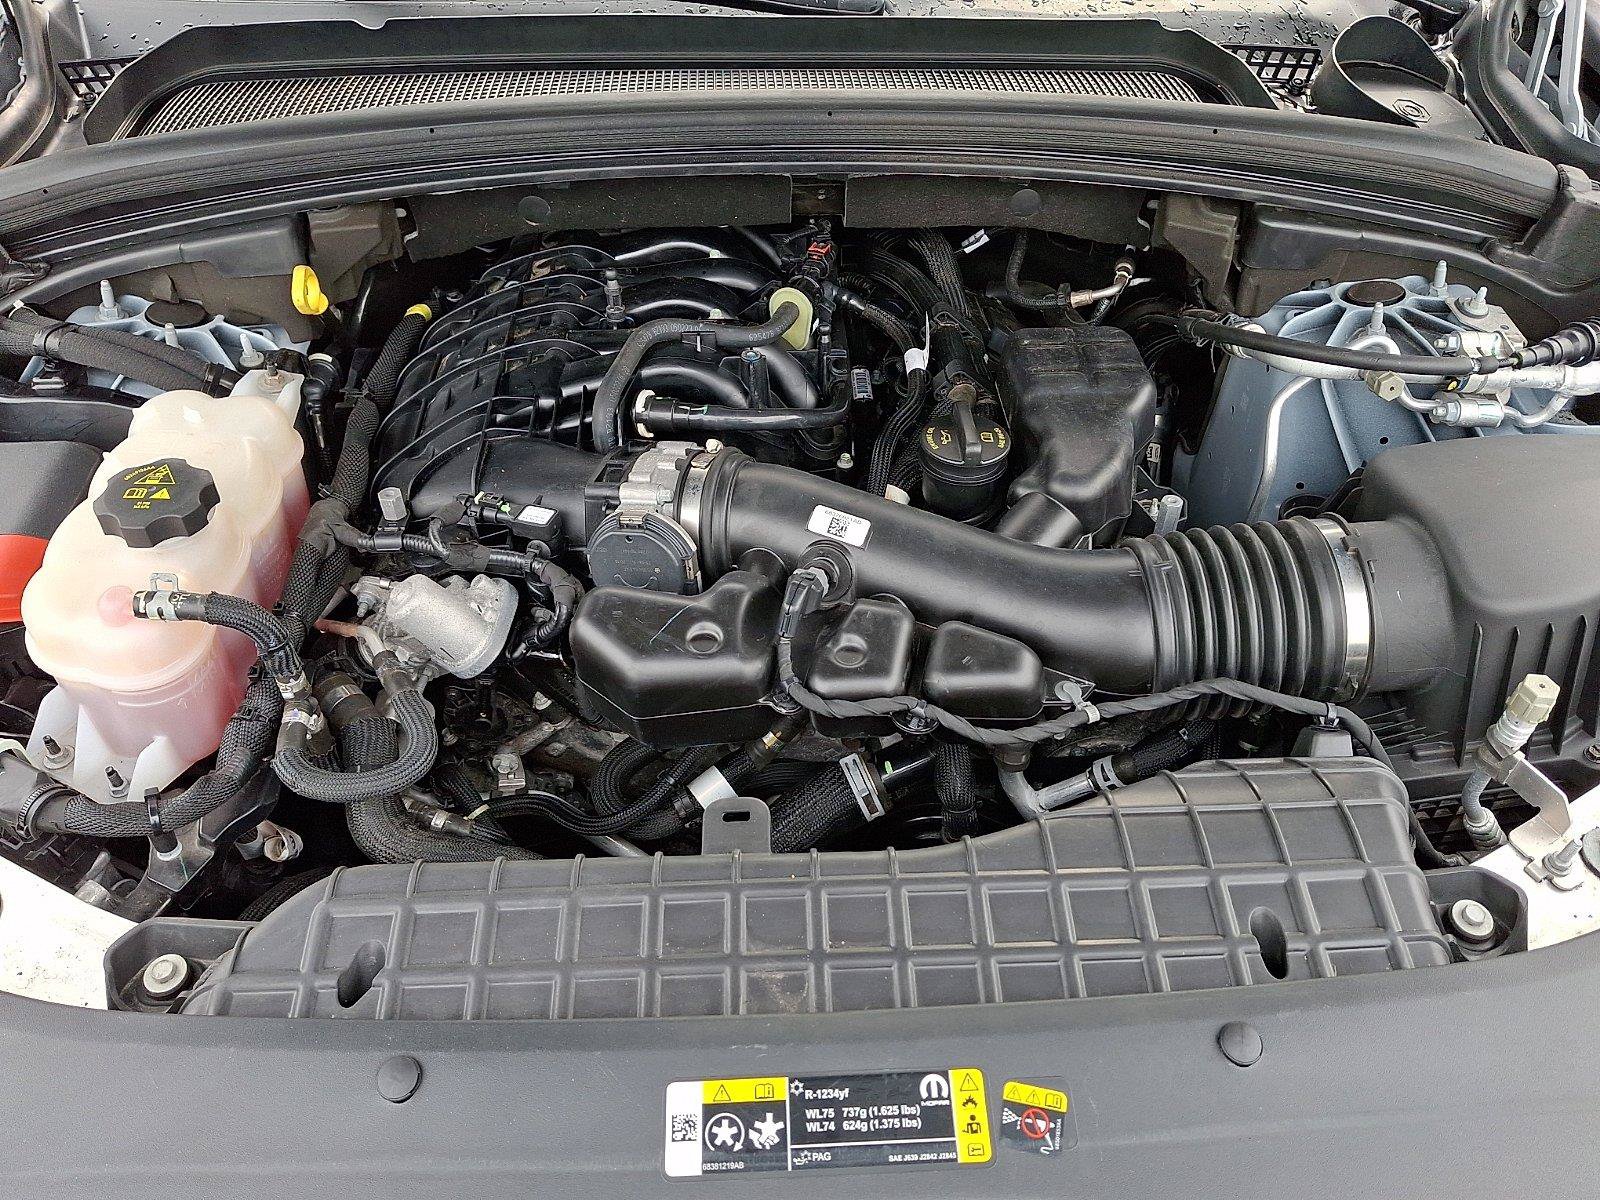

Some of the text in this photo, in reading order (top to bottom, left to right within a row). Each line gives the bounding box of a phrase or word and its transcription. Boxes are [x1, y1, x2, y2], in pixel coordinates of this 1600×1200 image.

[804, 1088, 850, 1100] R-1234yf
[805, 1104, 921, 1119] WL75 737g (1.625 lbs)
[806, 1117, 922, 1133] WL74 624g (1.375 lbs)
[812, 1152, 832, 1161] PAG
[888, 1154, 903, 1162] SAE
[702, 1161, 745, 1171] 68381219AB
